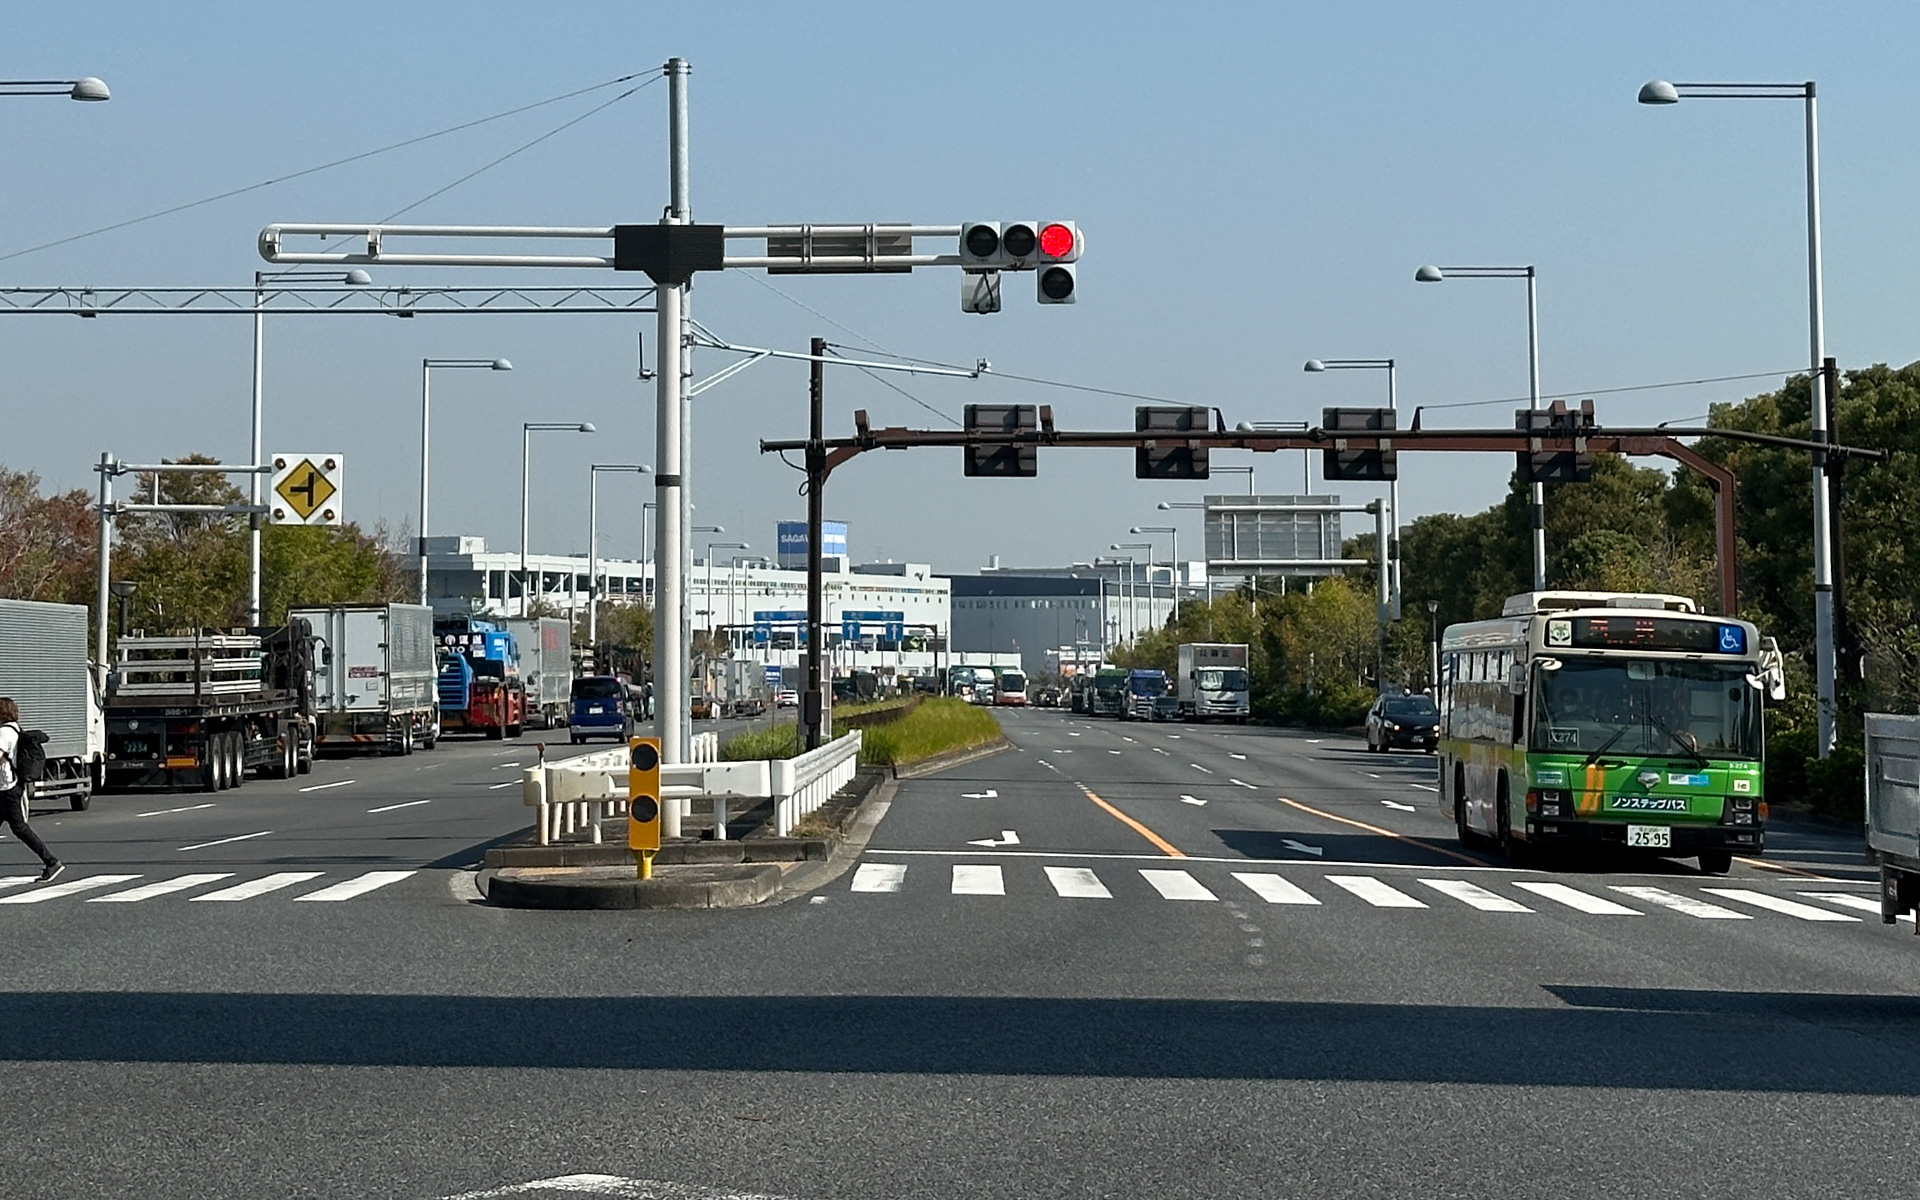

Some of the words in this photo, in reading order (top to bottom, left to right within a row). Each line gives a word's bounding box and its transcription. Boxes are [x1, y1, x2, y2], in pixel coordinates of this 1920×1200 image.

[1612, 797, 1687, 811] ノンステップバス
